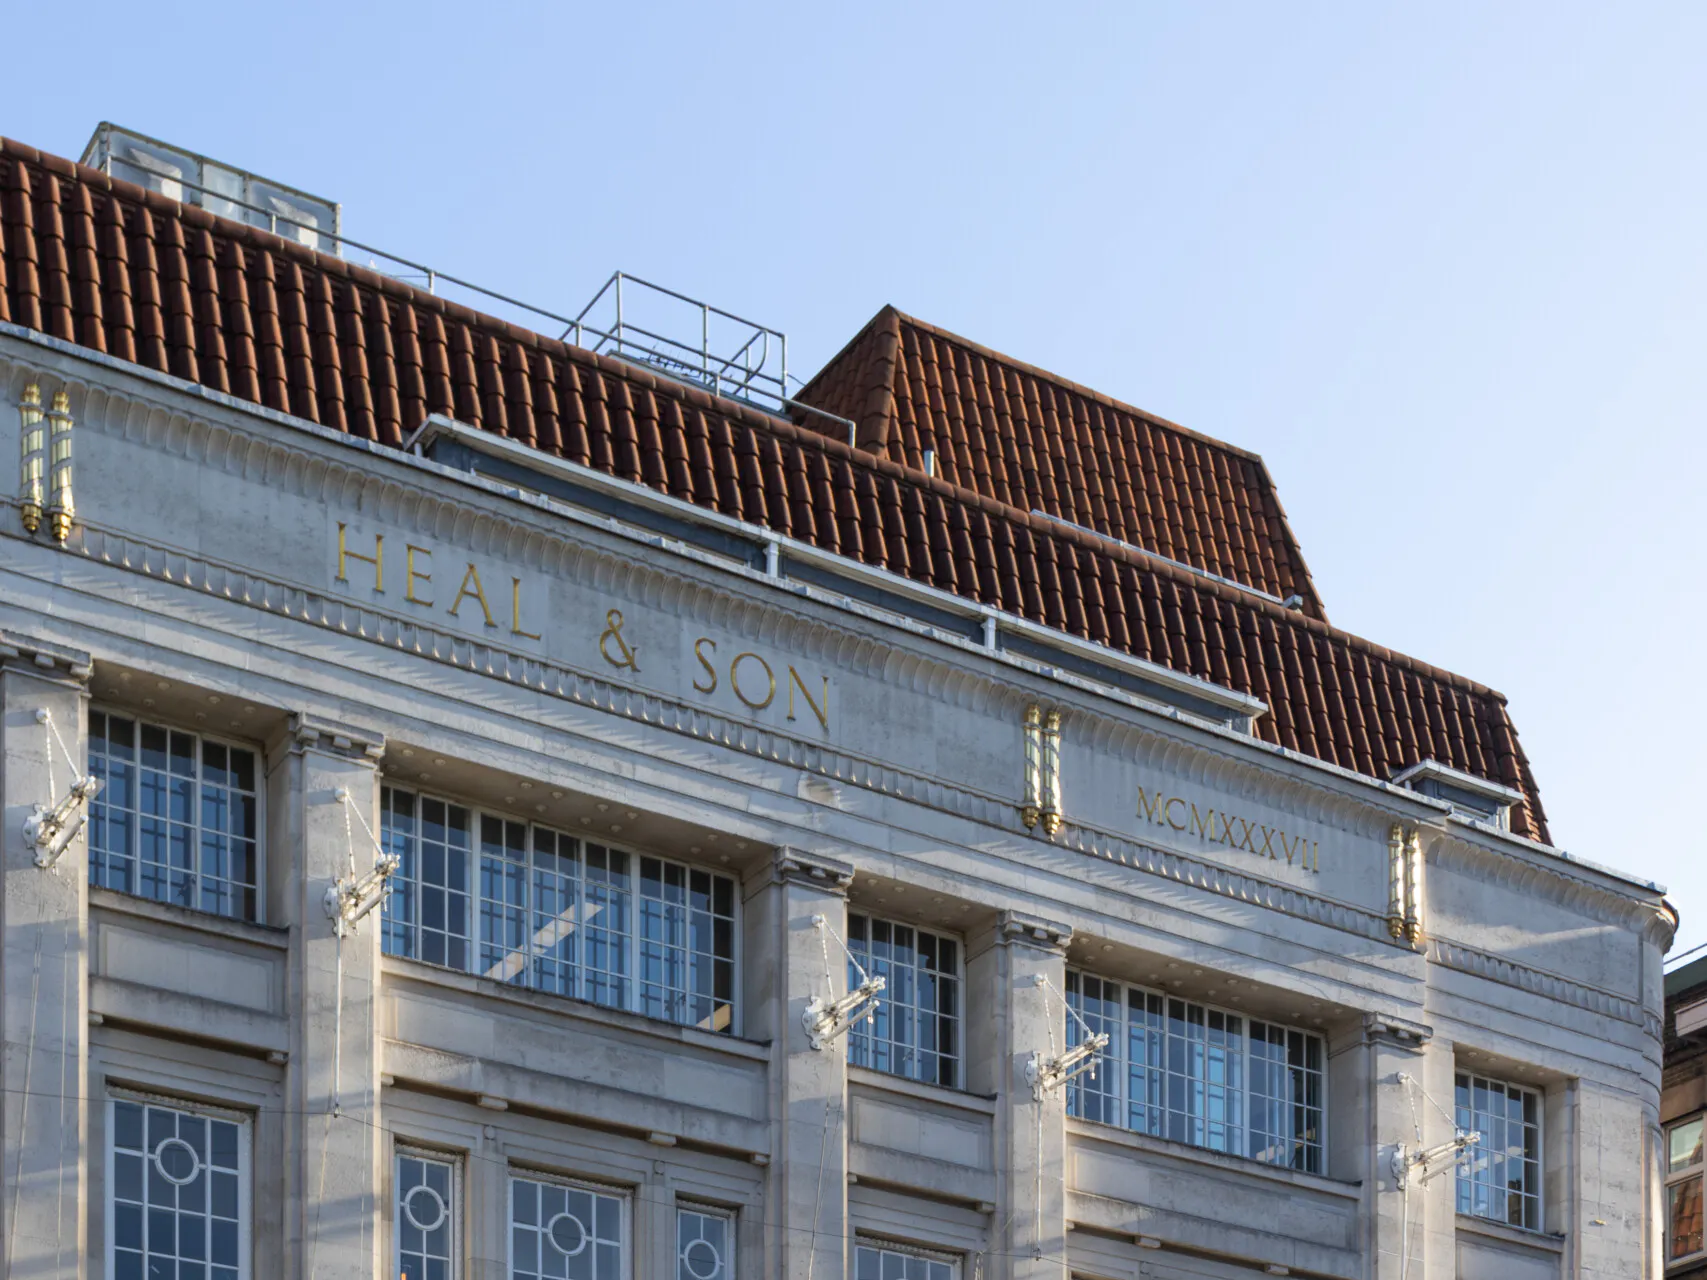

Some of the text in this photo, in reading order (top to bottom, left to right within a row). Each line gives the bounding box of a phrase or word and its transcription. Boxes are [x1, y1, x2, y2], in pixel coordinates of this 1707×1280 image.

[334, 520, 830, 733] HEAL & SON
[1136, 786, 1319, 873] MCMXXXVII
